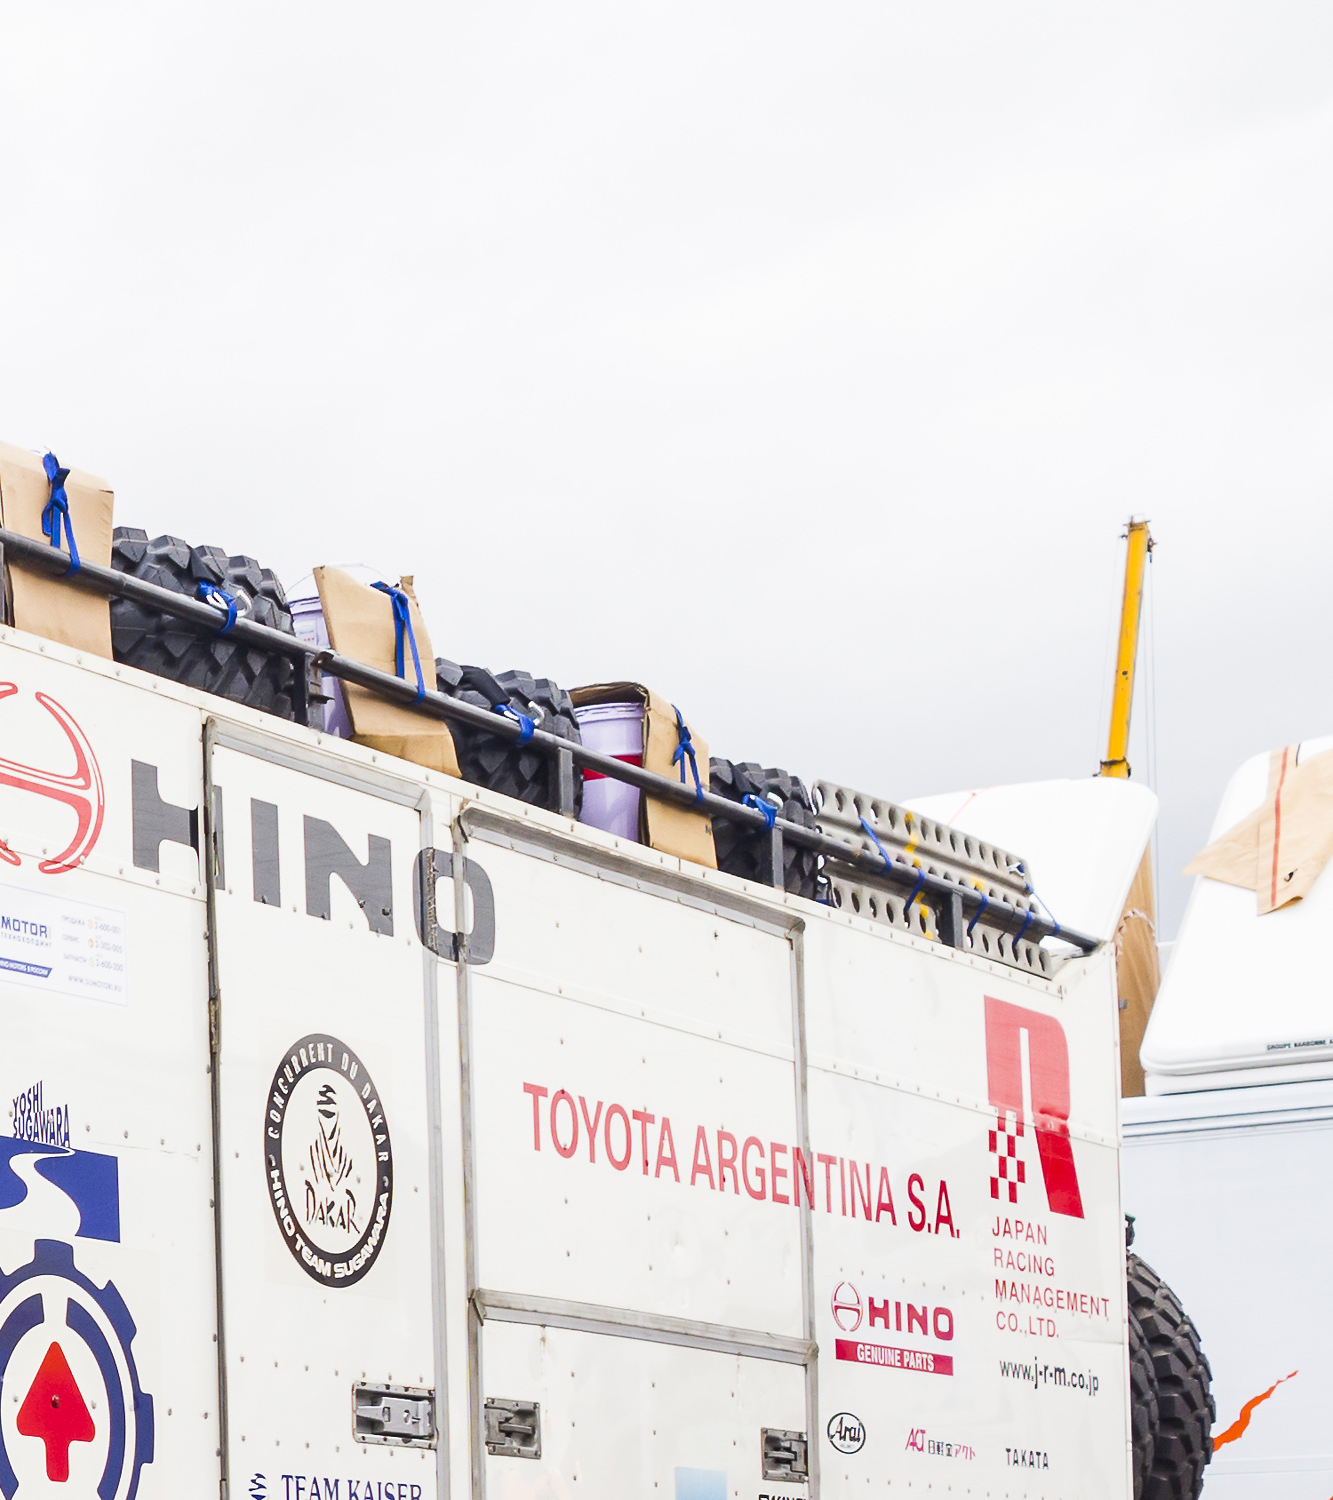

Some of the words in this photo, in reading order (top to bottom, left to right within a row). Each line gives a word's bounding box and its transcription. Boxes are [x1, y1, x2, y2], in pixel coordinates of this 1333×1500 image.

[131, 758, 496, 966] HINO
[12, 1079, 43, 1114] YOSHI
[267, 1042, 333, 1140] CONCURRENT
[341, 1052, 358, 1080] DU
[361, 1082, 389, 1162] DAKAR
[12, 1102, 71, 1149] SUGAWARA
[522, 1081, 680, 1184] TOYOTA
[690, 1124, 898, 1227] ARGENTINA
[907, 1172, 961, 1239] S.A.
[270, 1169, 296, 1236] HINO
[295, 1234, 331, 1278] TEAM
[334, 1192, 390, 1278] SUGAWARA
[304, 1180, 361, 1234] DAKAR
[992, 1216, 1048, 1246] JAPAN
[993, 1248, 1055, 1277] RACING
[868, 1296, 954, 1341] HINO
[995, 1279, 1110, 1318] MANAGEMENT
[856, 1343, 901, 1368] GENUINE
[903, 1351, 935, 1371] PARTS
[1005, 1448, 1050, 1470] TAKATA
